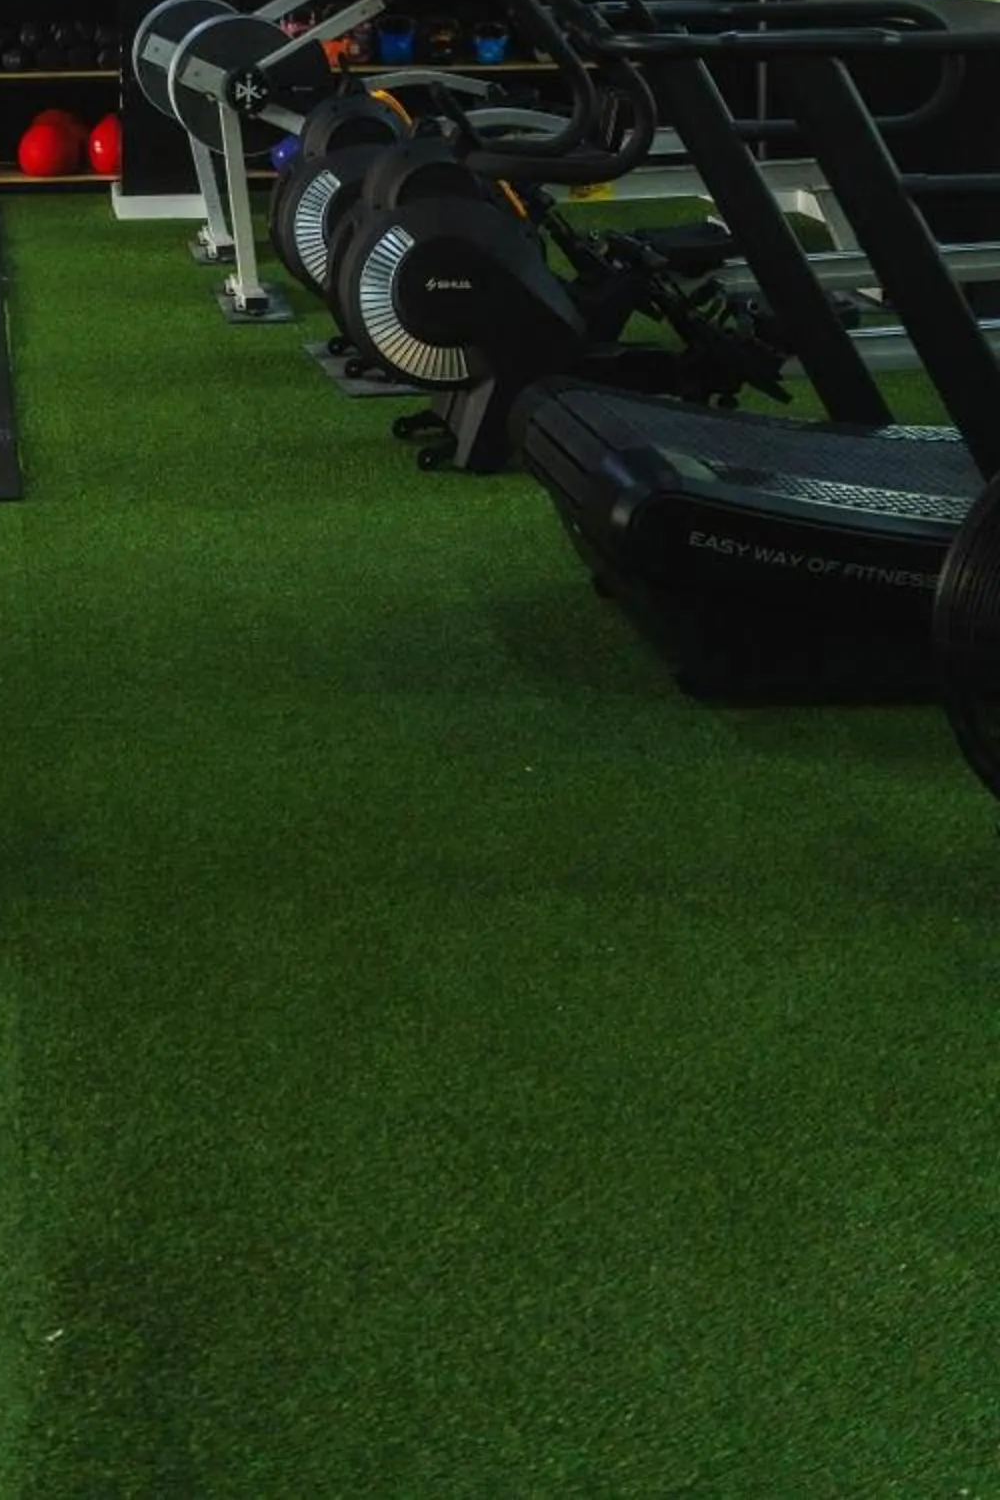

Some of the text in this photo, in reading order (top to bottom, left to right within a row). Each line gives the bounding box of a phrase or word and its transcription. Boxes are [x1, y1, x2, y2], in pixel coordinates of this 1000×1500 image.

[689, 530, 750, 557] EASY
[754, 546, 804, 567] WAY
[807, 557, 841, 576] OF
